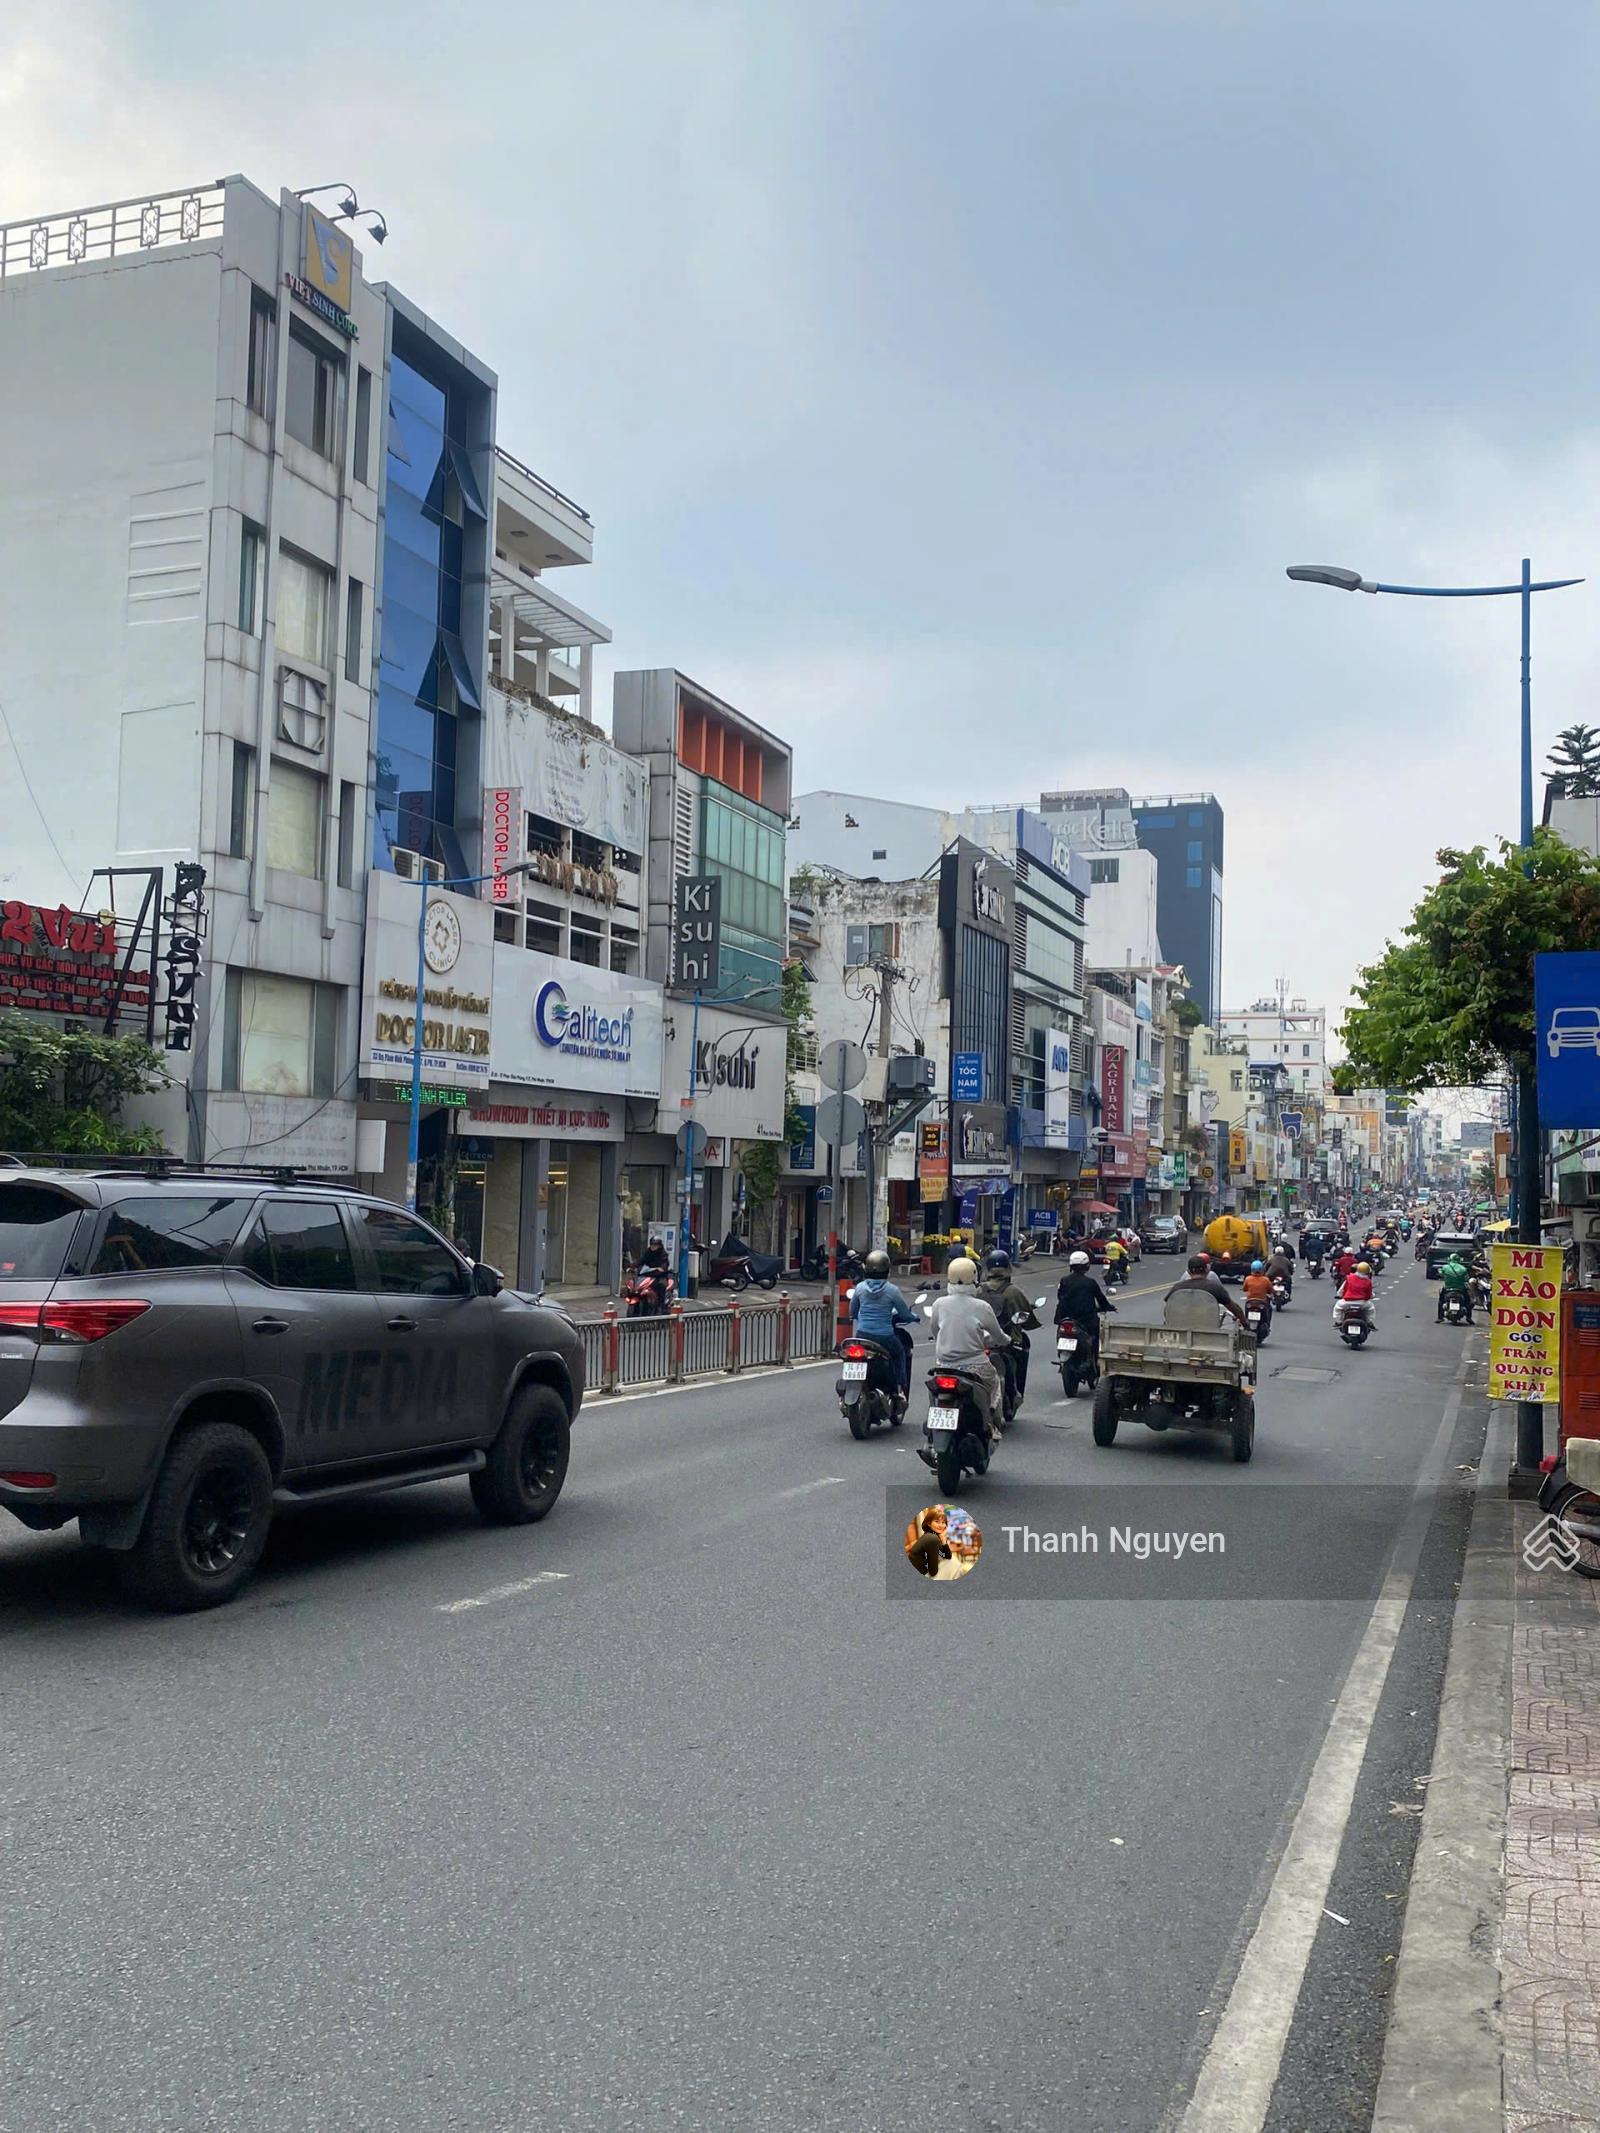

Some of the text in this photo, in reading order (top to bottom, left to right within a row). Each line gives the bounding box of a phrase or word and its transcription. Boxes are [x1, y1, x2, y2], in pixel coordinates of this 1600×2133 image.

[312, 291, 336, 320] SINH
[492, 791, 510, 900] DOCTOR LASER
[1050, 836, 1071, 876] ACB
[683, 883, 711, 912] Ki
[3, 900, 33, 945] 2
[37, 903, 118, 955] Vui
[424, 905, 446, 937] DOCTOR
[680, 921, 713, 943] su
[428, 952, 453, 969] CLINIC
[682, 951, 709, 981] hi
[376, 1012, 445, 1049] DOCOR
[695, 1039, 757, 1091] Kisuhi
[959, 1066, 977, 1075] TÓC
[1051, 1044, 1069, 1073] ACB
[957, 1079, 978, 1087] NAM
[1106, 1062, 1118, 1130] AGRIBANK
[439, 1090, 467, 1107] FILLER
[1034, 1211, 1051, 1220] ACB
[1511, 1247, 1545, 1269] MÌ
[1497, 1276, 1557, 1300] XÀO
[1496, 1305, 1556, 1329] DÒN
[1509, 1330, 1542, 1344] GỐC
[1495, 1363, 1553, 1377] QUANG
